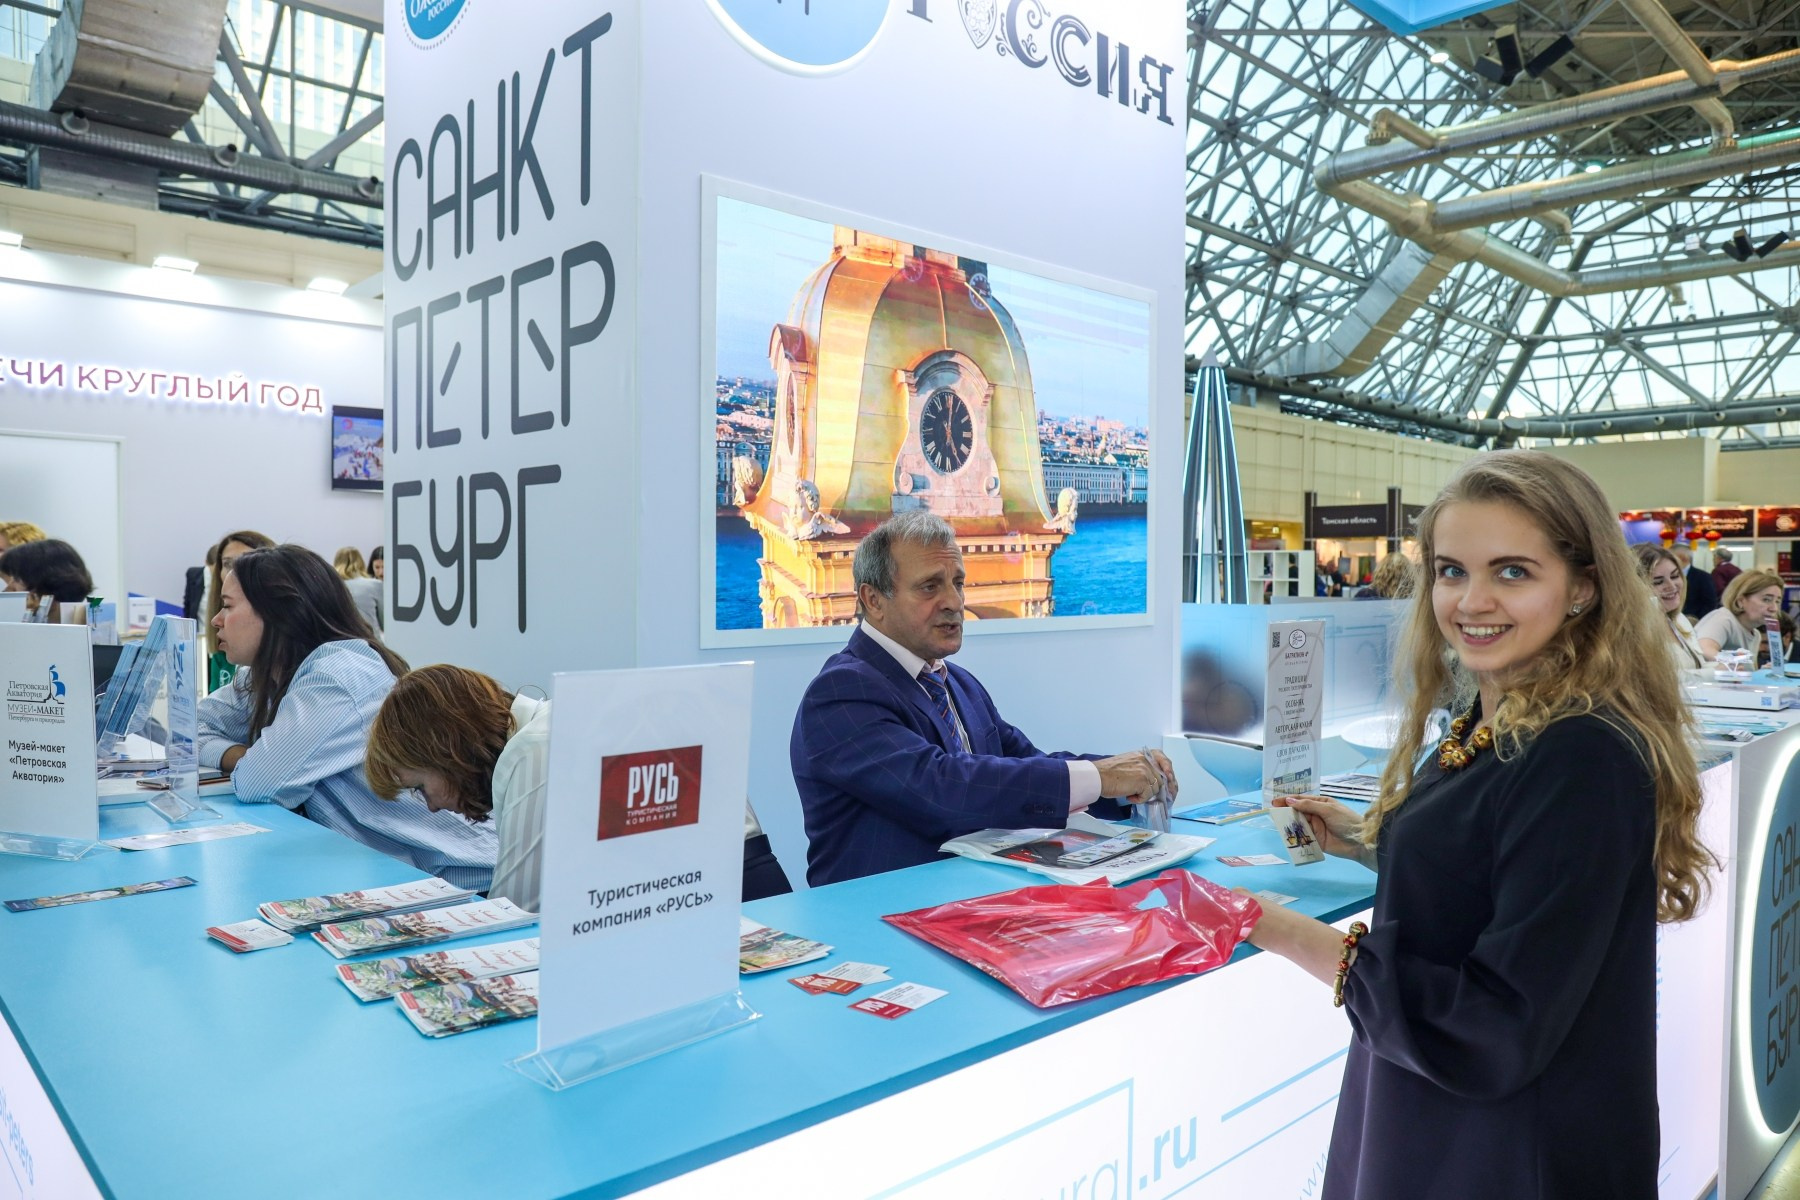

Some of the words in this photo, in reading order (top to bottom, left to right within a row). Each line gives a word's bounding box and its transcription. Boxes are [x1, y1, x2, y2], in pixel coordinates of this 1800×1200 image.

[392, 13, 613, 281] САНКТ
[392, 241, 616, 454] ПЕТЕР
[0, 358, 63, 387] ЧИ
[78, 365, 249, 403] КРУГЛЫЙ
[260, 384, 323, 413] ГОД
[392, 464, 561, 634] БУРГ
[7, 688, 43, 700] Акватория
[9, 681, 49, 691] Петровская
[9, 739, 66, 753] Музей-макет
[10, 755, 67, 768] «Петровская
[12, 769, 65, 784] Акватория»
[627, 762, 679, 808] РУСЬ
[626, 812, 677, 826] КОМПАНИЯ
[627, 804, 678, 817] ТУРИСТИЧЕСКАЯ
[588, 870, 702, 909] Туристическая
[573, 905, 651, 936] компания
[656, 892, 714, 915] «РУСЬ»
